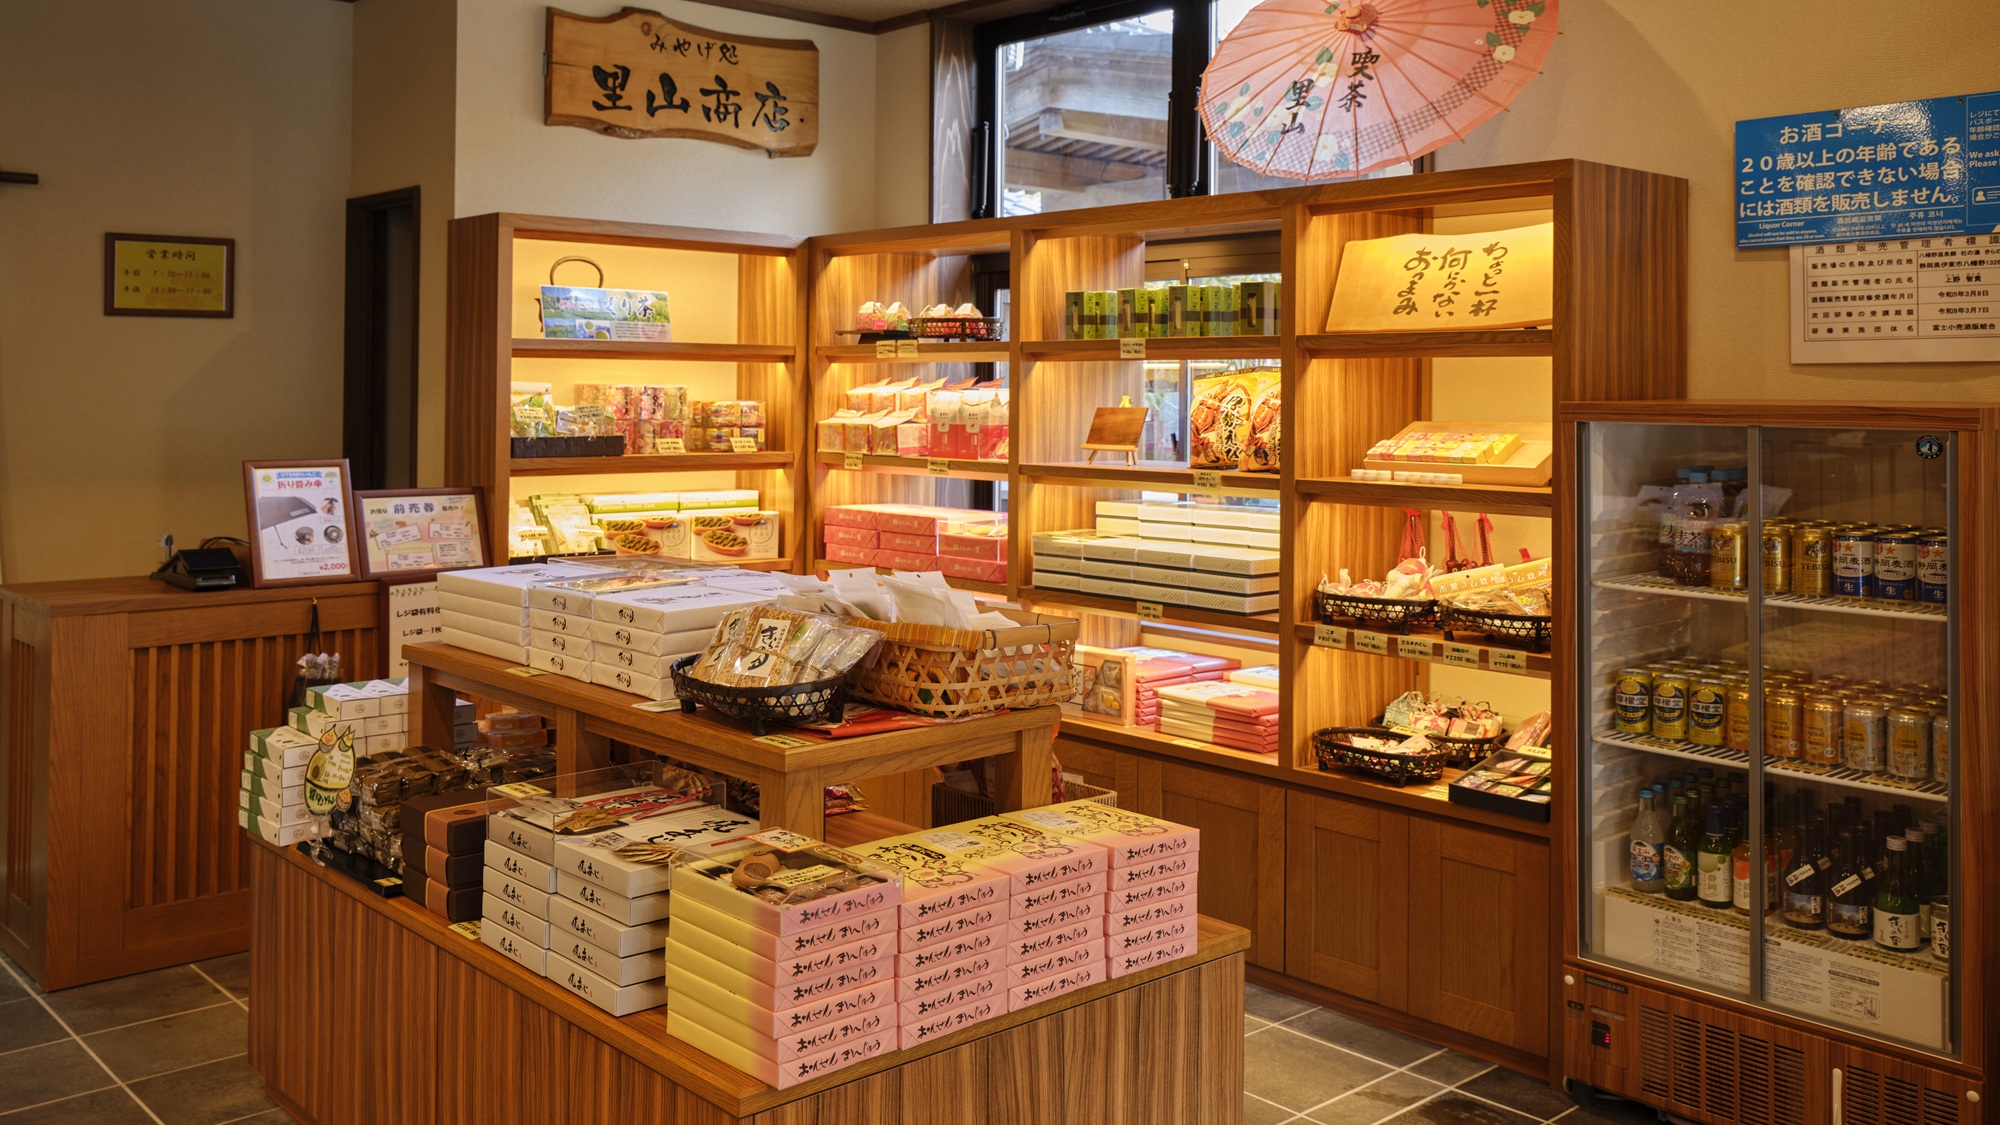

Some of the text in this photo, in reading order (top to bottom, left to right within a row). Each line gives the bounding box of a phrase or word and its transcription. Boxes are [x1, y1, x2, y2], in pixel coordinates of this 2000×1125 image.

[650, 34, 739, 65] みやげ処
[1338, 46, 1380, 112] 喫茶
[592, 64, 790, 132] 里山商店
[1281, 78, 1313, 134] 里山
[1741, 137, 1961, 173] 20歳以上の年齢である
[1970, 151, 1983, 159] We
[1740, 160, 1961, 196] ことを確認できない場合
[1740, 186, 1959, 218] には酒類を販売しません。
[1759, 222, 1780, 230] Liquor
[146, 249, 196, 261] 営業時間
[1392, 247, 1438, 316] おつまみ
[1469, 241, 1508, 317] ちょっと一杯
[277, 480, 322, 489] 折り畳み傘
[393, 502, 436, 514] 前売券
[1676, 530, 1704, 547] 麦茶
[1843, 582, 1854, 591] 生
[1886, 586, 1896, 595] 生
[1933, 589, 1943, 599] 生
[1586, 977, 1625, 992] HOSHIZAKI
